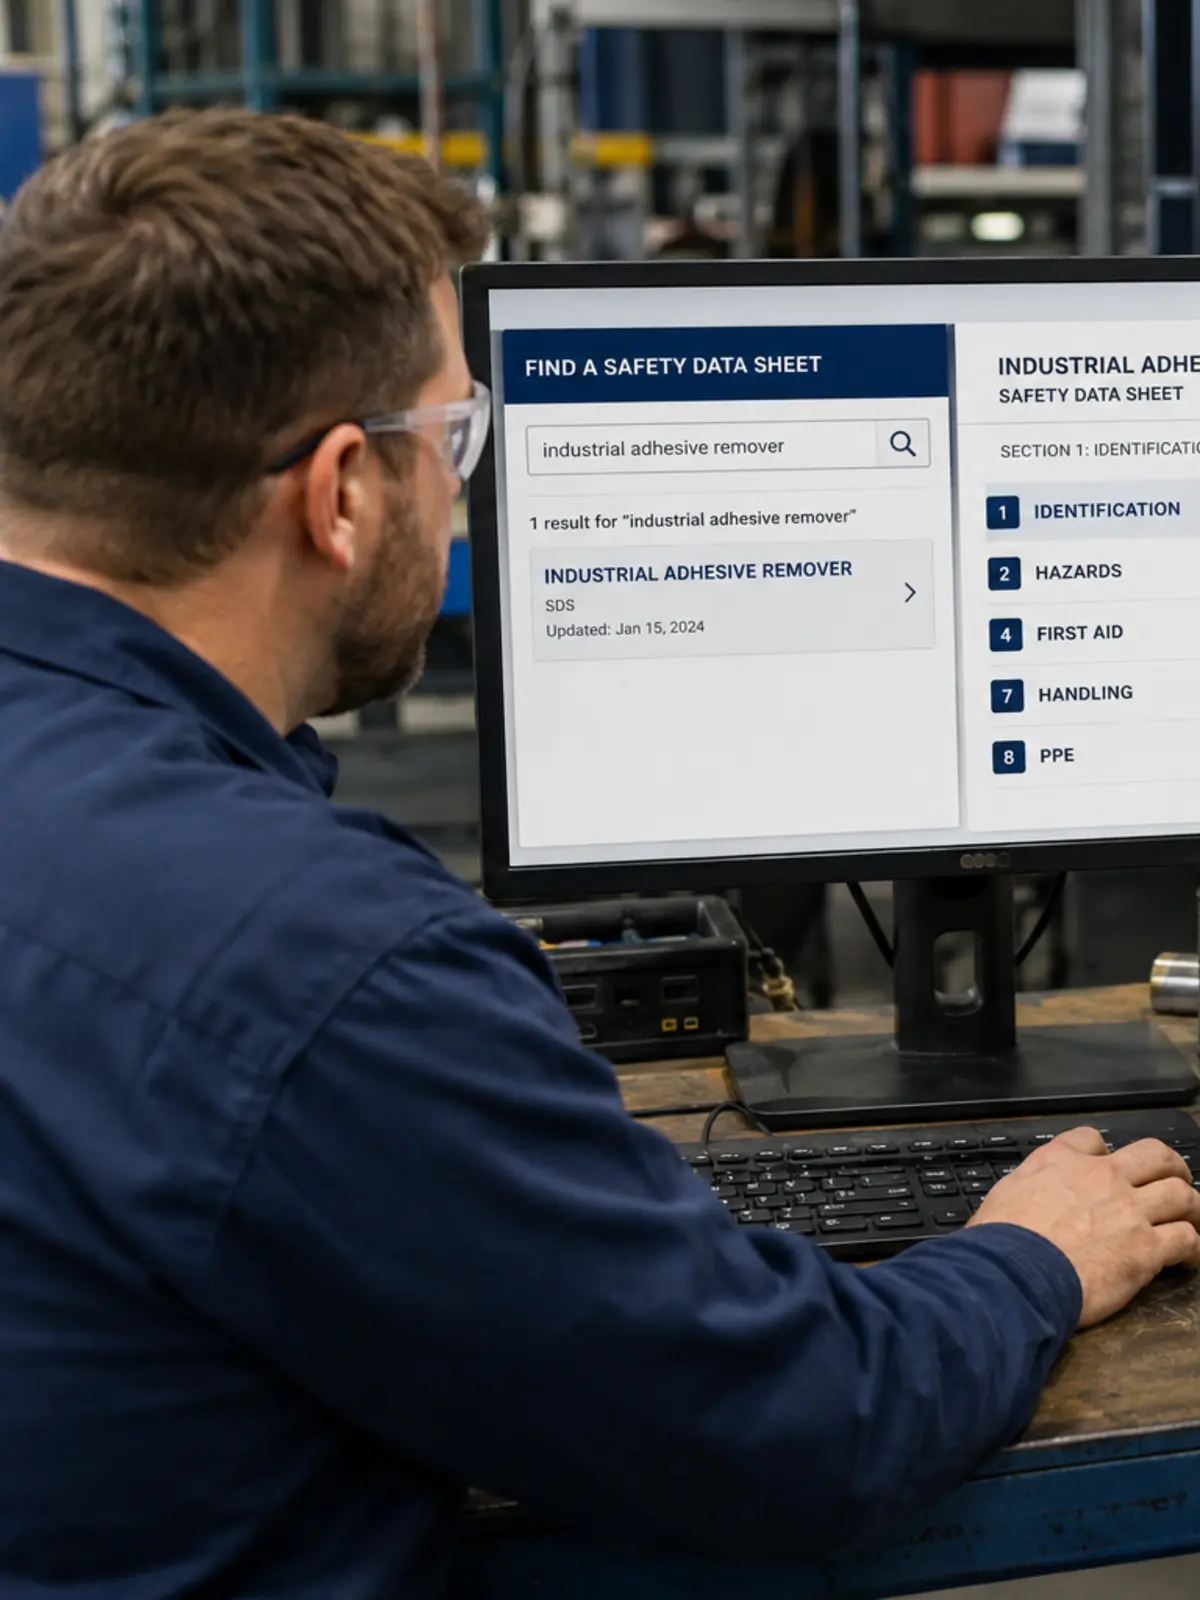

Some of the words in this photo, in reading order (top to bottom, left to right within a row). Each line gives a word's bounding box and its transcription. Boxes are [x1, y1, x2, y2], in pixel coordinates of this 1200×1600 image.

[525, 358, 576, 377] FIND
[582, 358, 598, 376] A
[604, 357, 687, 376] SAFETY
[693, 356, 748, 374] DATA
[754, 355, 822, 374] SHEET
[998, 355, 1135, 376] INDUSTRIAL
[999, 387, 1069, 404] SAFETY
[1074, 386, 1122, 403] DATA
[1126, 385, 1184, 402] SHEET
[543, 440, 625, 458] industrial
[630, 439, 709, 457] adhesive
[713, 441, 785, 455] remover
[1000, 443, 1071, 459] SECTION
[1076, 443, 1089, 457] 1:
[998, 505, 1006, 520] 1
[1034, 501, 1181, 519] IDENTIFICATION
[530, 516, 537, 530] 1
[544, 514, 591, 531] result
[594, 513, 618, 529] for
[709, 510, 781, 526] adhesive
[544, 566, 659, 585] INDUSTRIAL
[663, 563, 757, 581] ADHESIVE
[762, 560, 853, 579] REMOVER
[999, 566, 1010, 582] 2
[1035, 563, 1123, 581] HAZARDS
[545, 598, 575, 613] SDS
[545, 622, 611, 640] Updated:
[615, 622, 641, 636] Jan
[645, 621, 667, 636] 15,
[669, 620, 705, 634] 2024
[1000, 627, 1012, 643] 4
[1037, 625, 1088, 642] FIRST
[1092, 624, 1124, 640] AID
[1001, 688, 1013, 704] 7
[1038, 684, 1133, 703] HANDLING
[1003, 749, 1015, 765] 8
[1040, 747, 1075, 763] PPE
